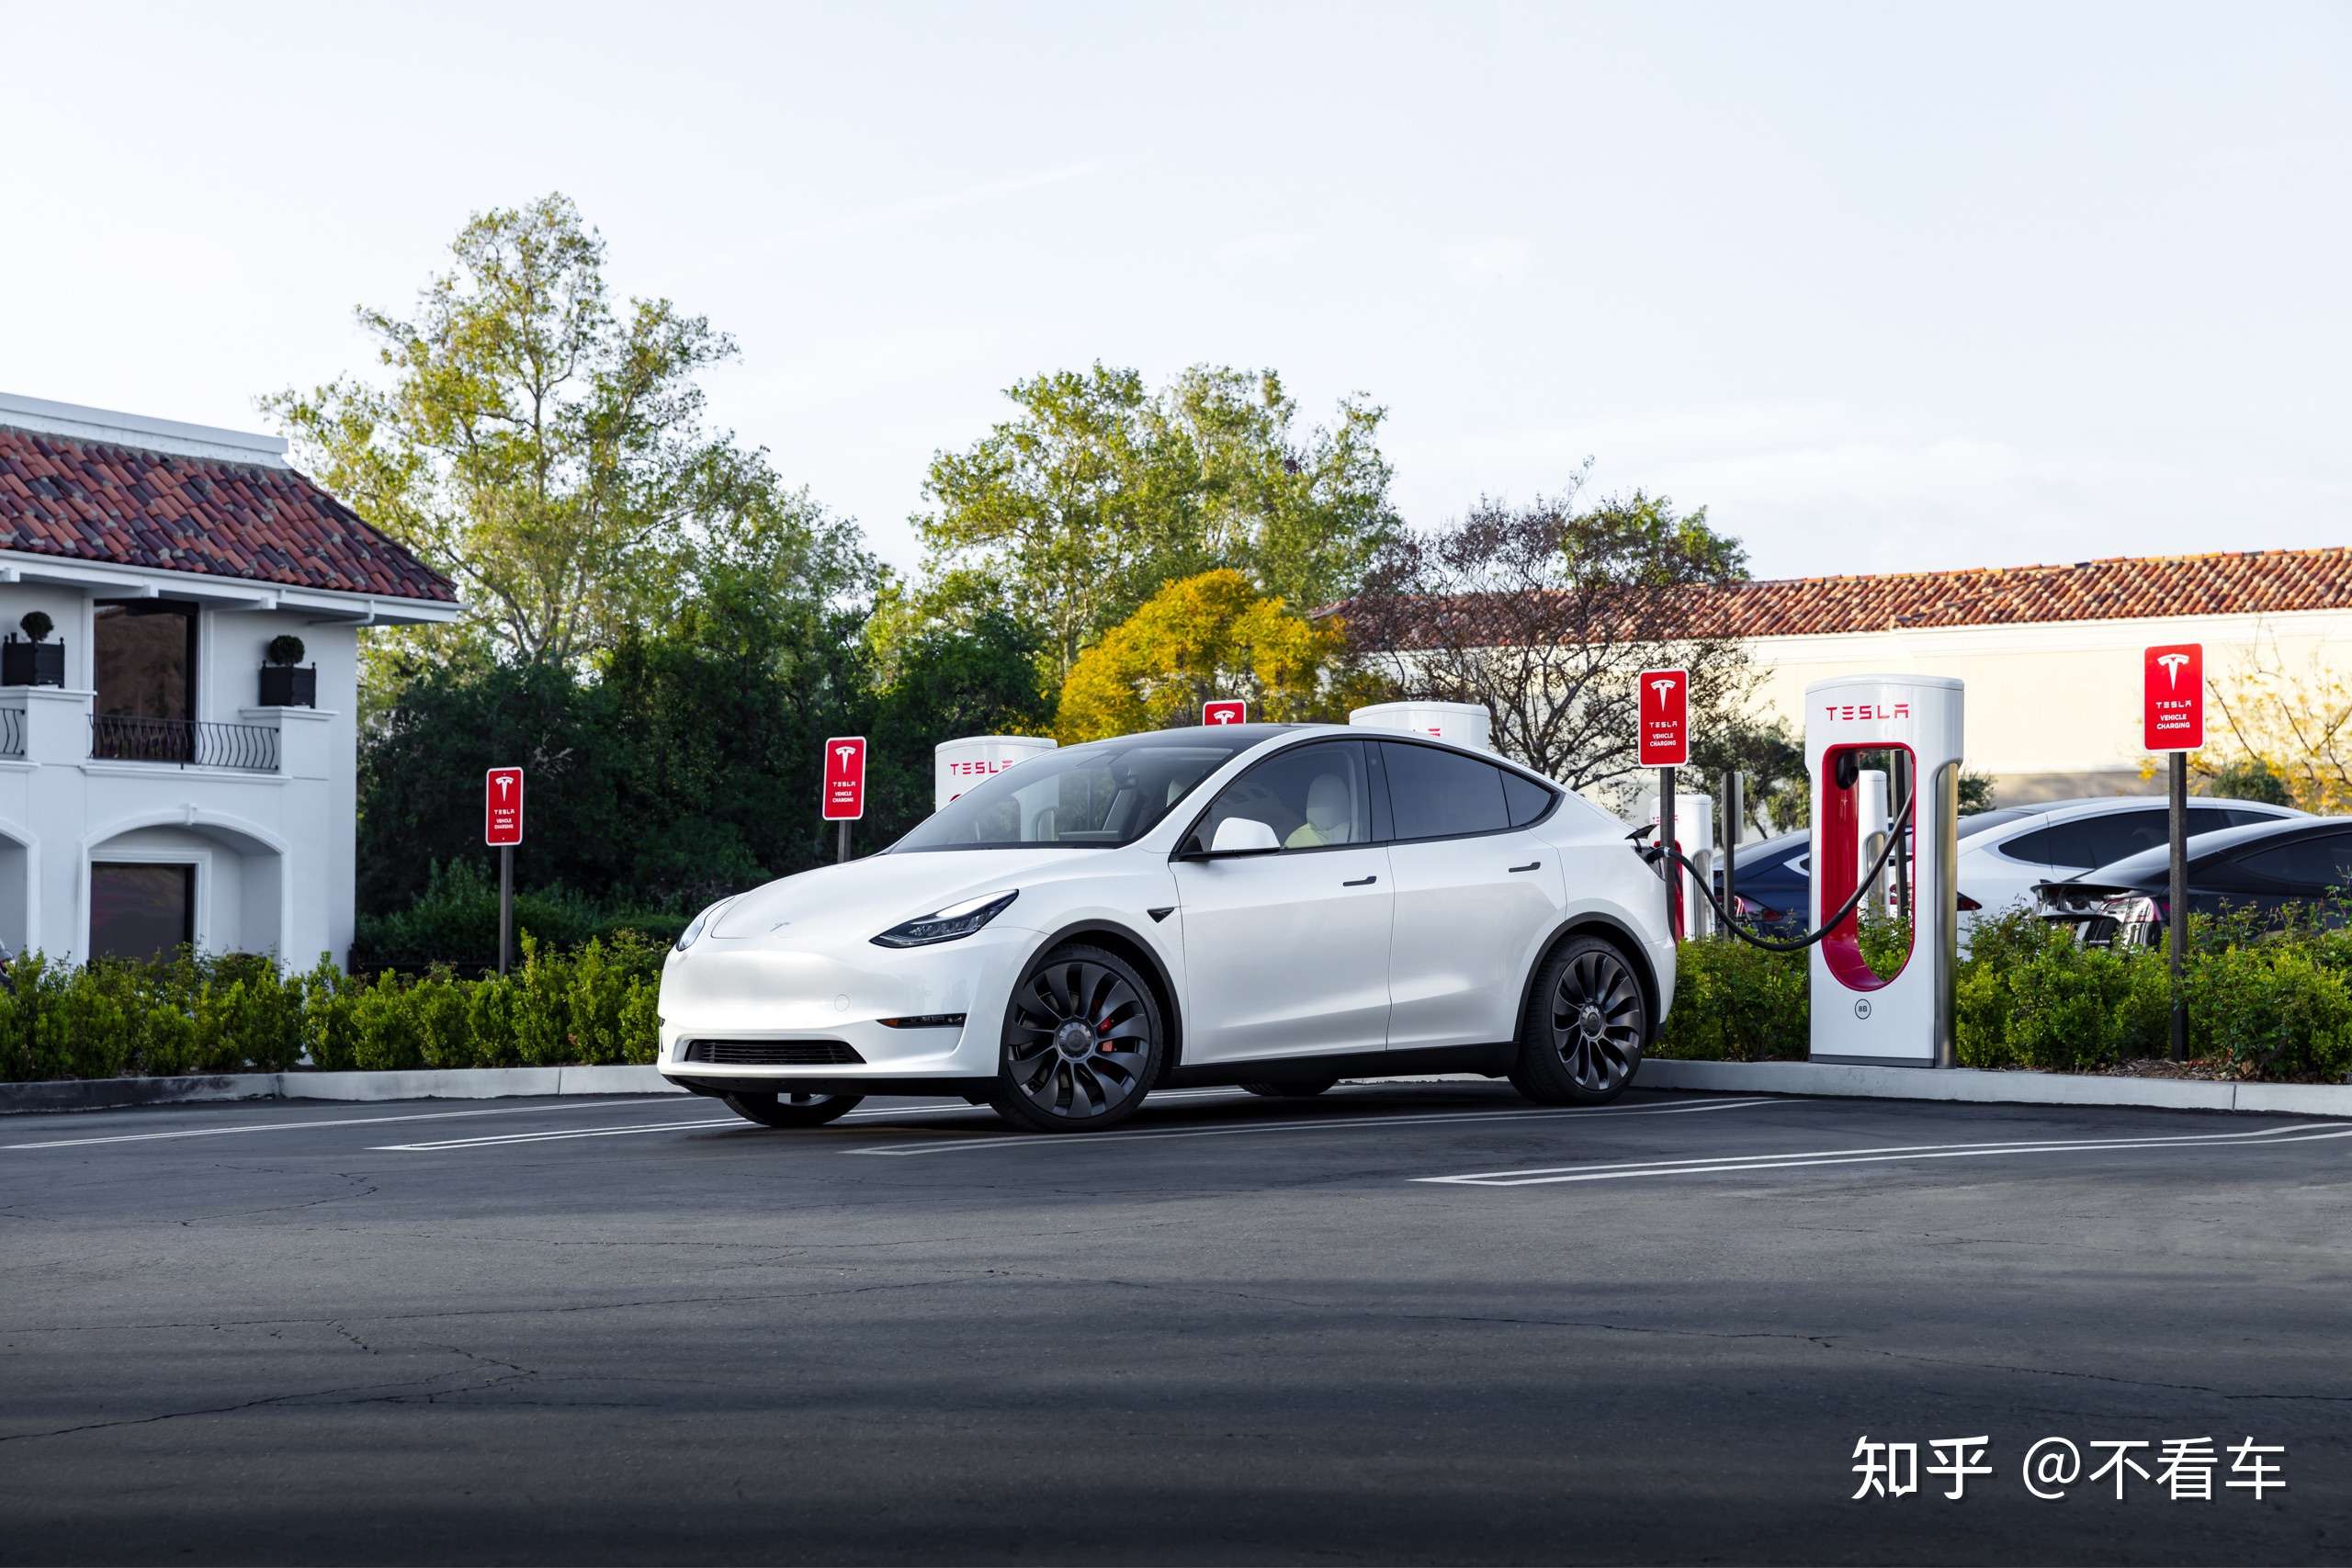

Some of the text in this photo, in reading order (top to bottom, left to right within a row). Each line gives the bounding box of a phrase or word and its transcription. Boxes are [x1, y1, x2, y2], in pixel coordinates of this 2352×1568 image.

[2155, 700, 2191, 709] TESLA
[1826, 704, 1909, 721] TESLA
[2156, 722, 2190, 730] CHARGING
